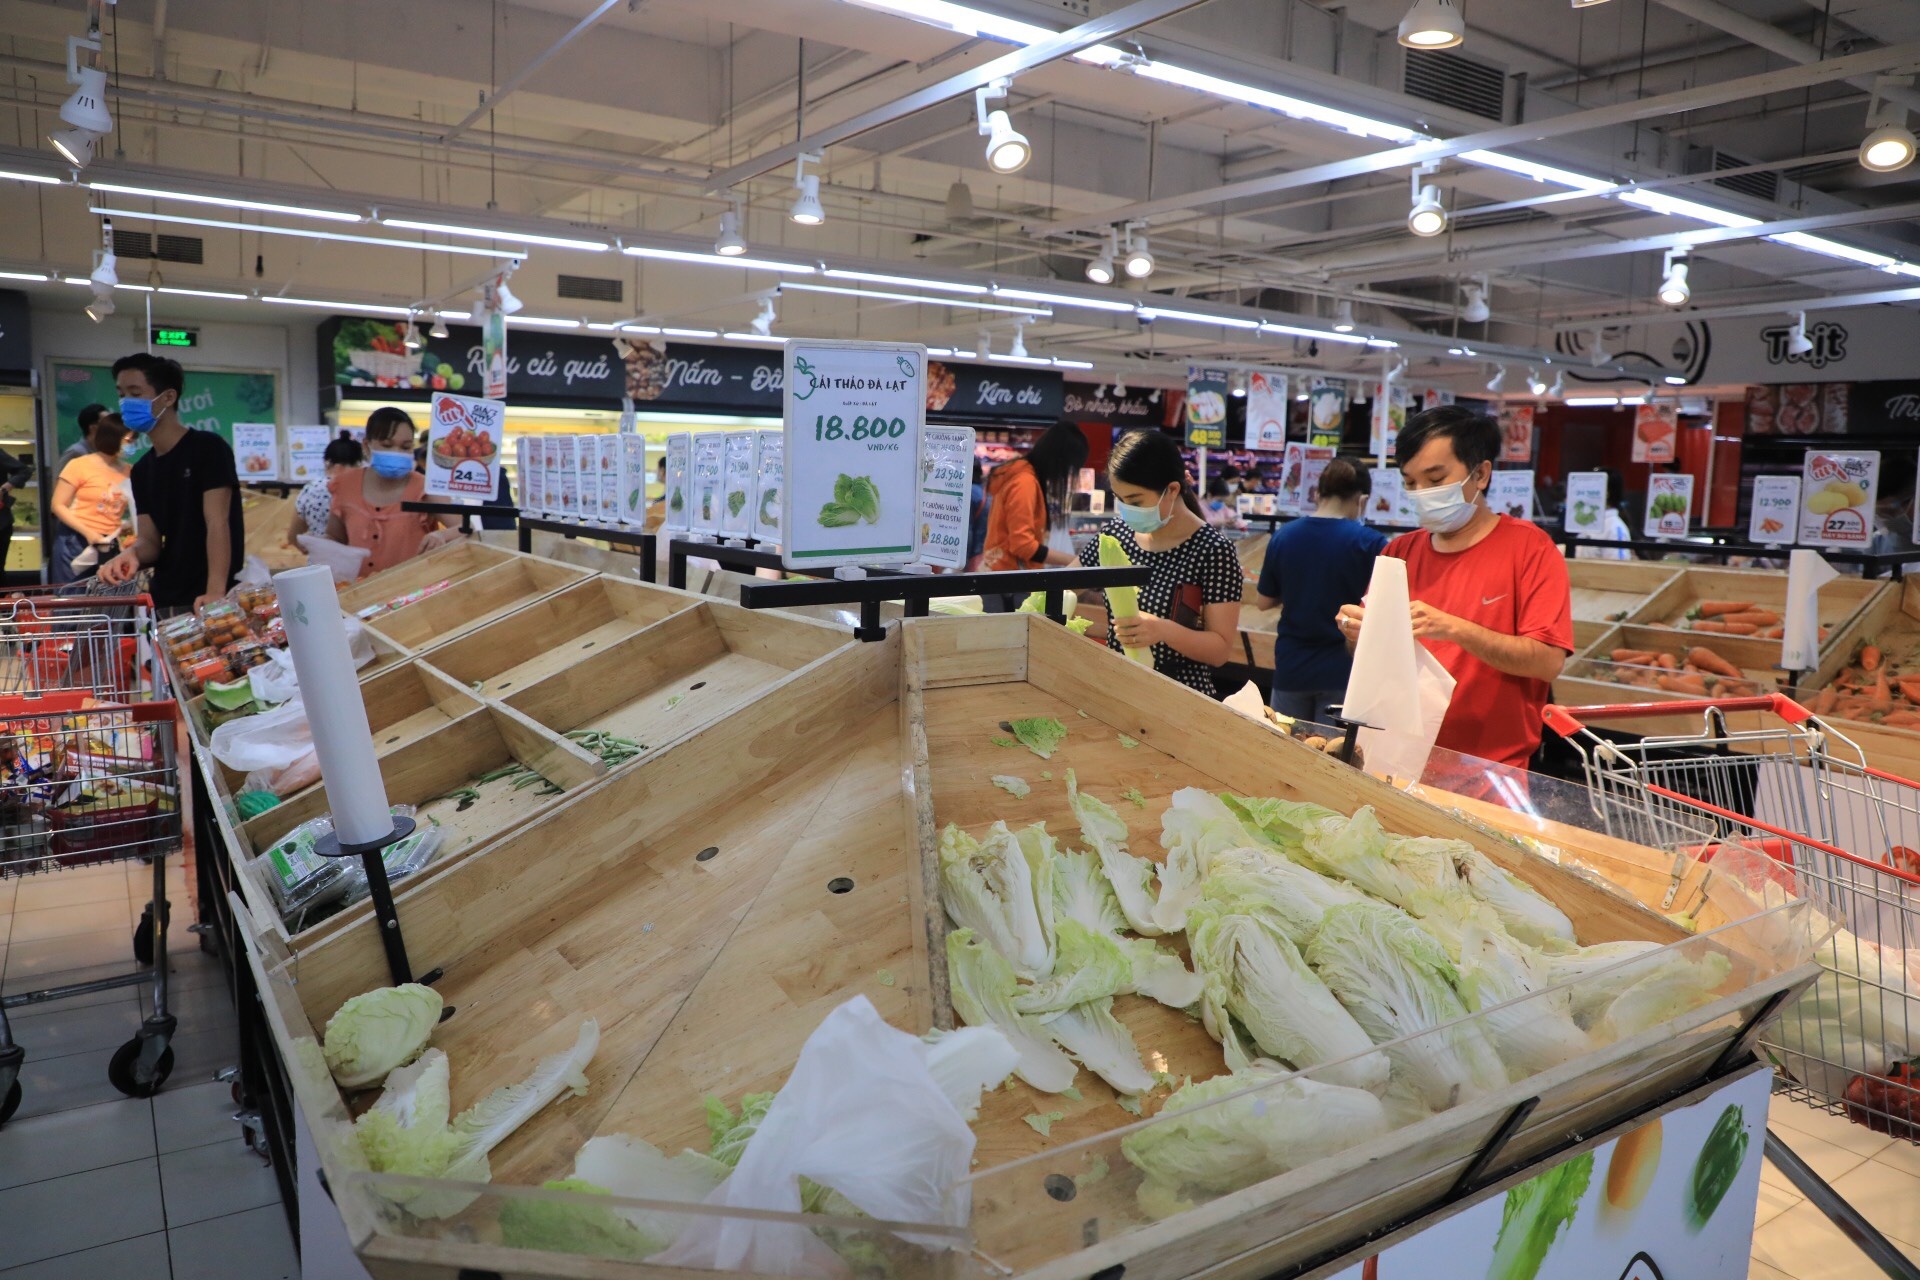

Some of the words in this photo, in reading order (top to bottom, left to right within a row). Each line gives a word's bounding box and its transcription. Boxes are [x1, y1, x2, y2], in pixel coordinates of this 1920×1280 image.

[466, 345, 520, 378] Ru
[527, 351, 558, 376] củ
[563, 354, 611, 385] quả
[662, 358, 723, 388] Nấm
[750, 365, 784, 392] Đậ
[886, 380, 907, 392] LẠT
[976, 379, 1014, 405] Kim
[1016, 384, 1042, 405] chi
[815, 415, 906, 441] 18.800
[867, 443, 899, 451] VND/KG
[454, 470, 473, 481] 24
[1828, 520, 1845, 530] 27
[930, 533, 960, 546] 28.800
